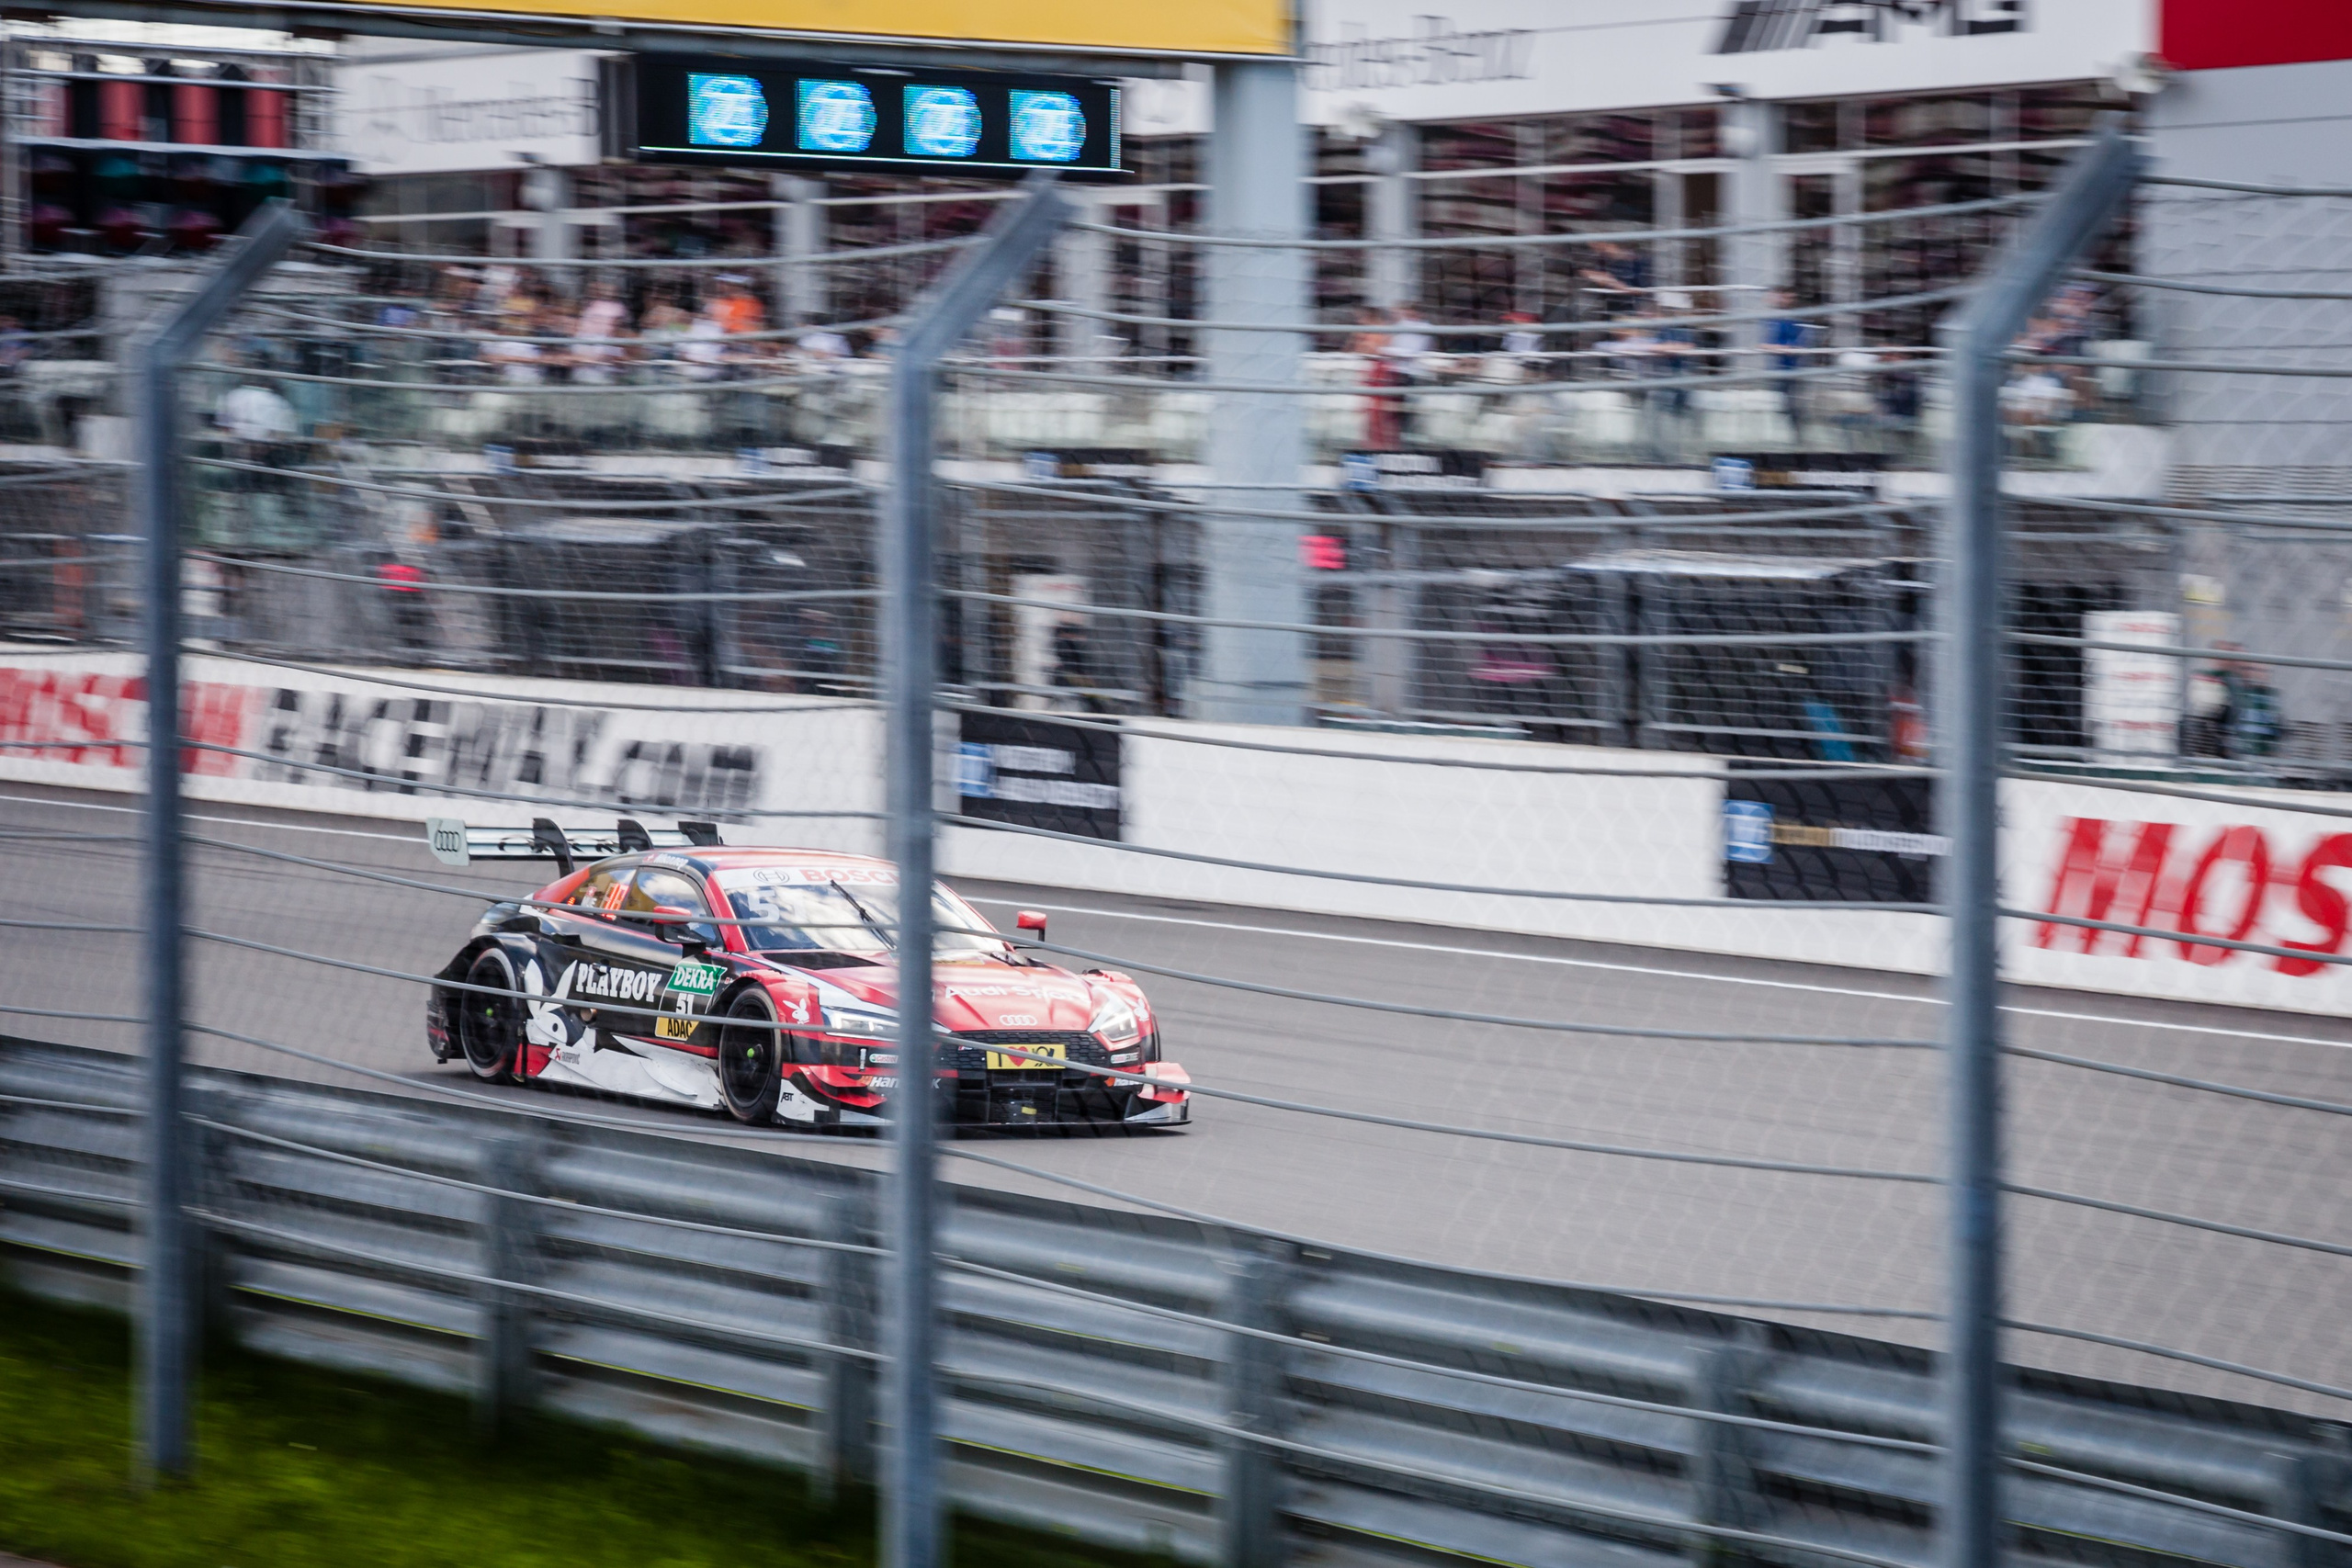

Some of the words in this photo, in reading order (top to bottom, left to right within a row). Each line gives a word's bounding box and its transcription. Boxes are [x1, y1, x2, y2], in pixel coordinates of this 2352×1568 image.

[575, 963, 662, 1003] PLAYBOY
[673, 965, 714, 991] DEKRA
[945, 986, 1008, 999] Audi
[675, 992, 695, 1016] 51
[667, 1018, 693, 1039] ADAC
[781, 1091, 795, 1103] ABT
